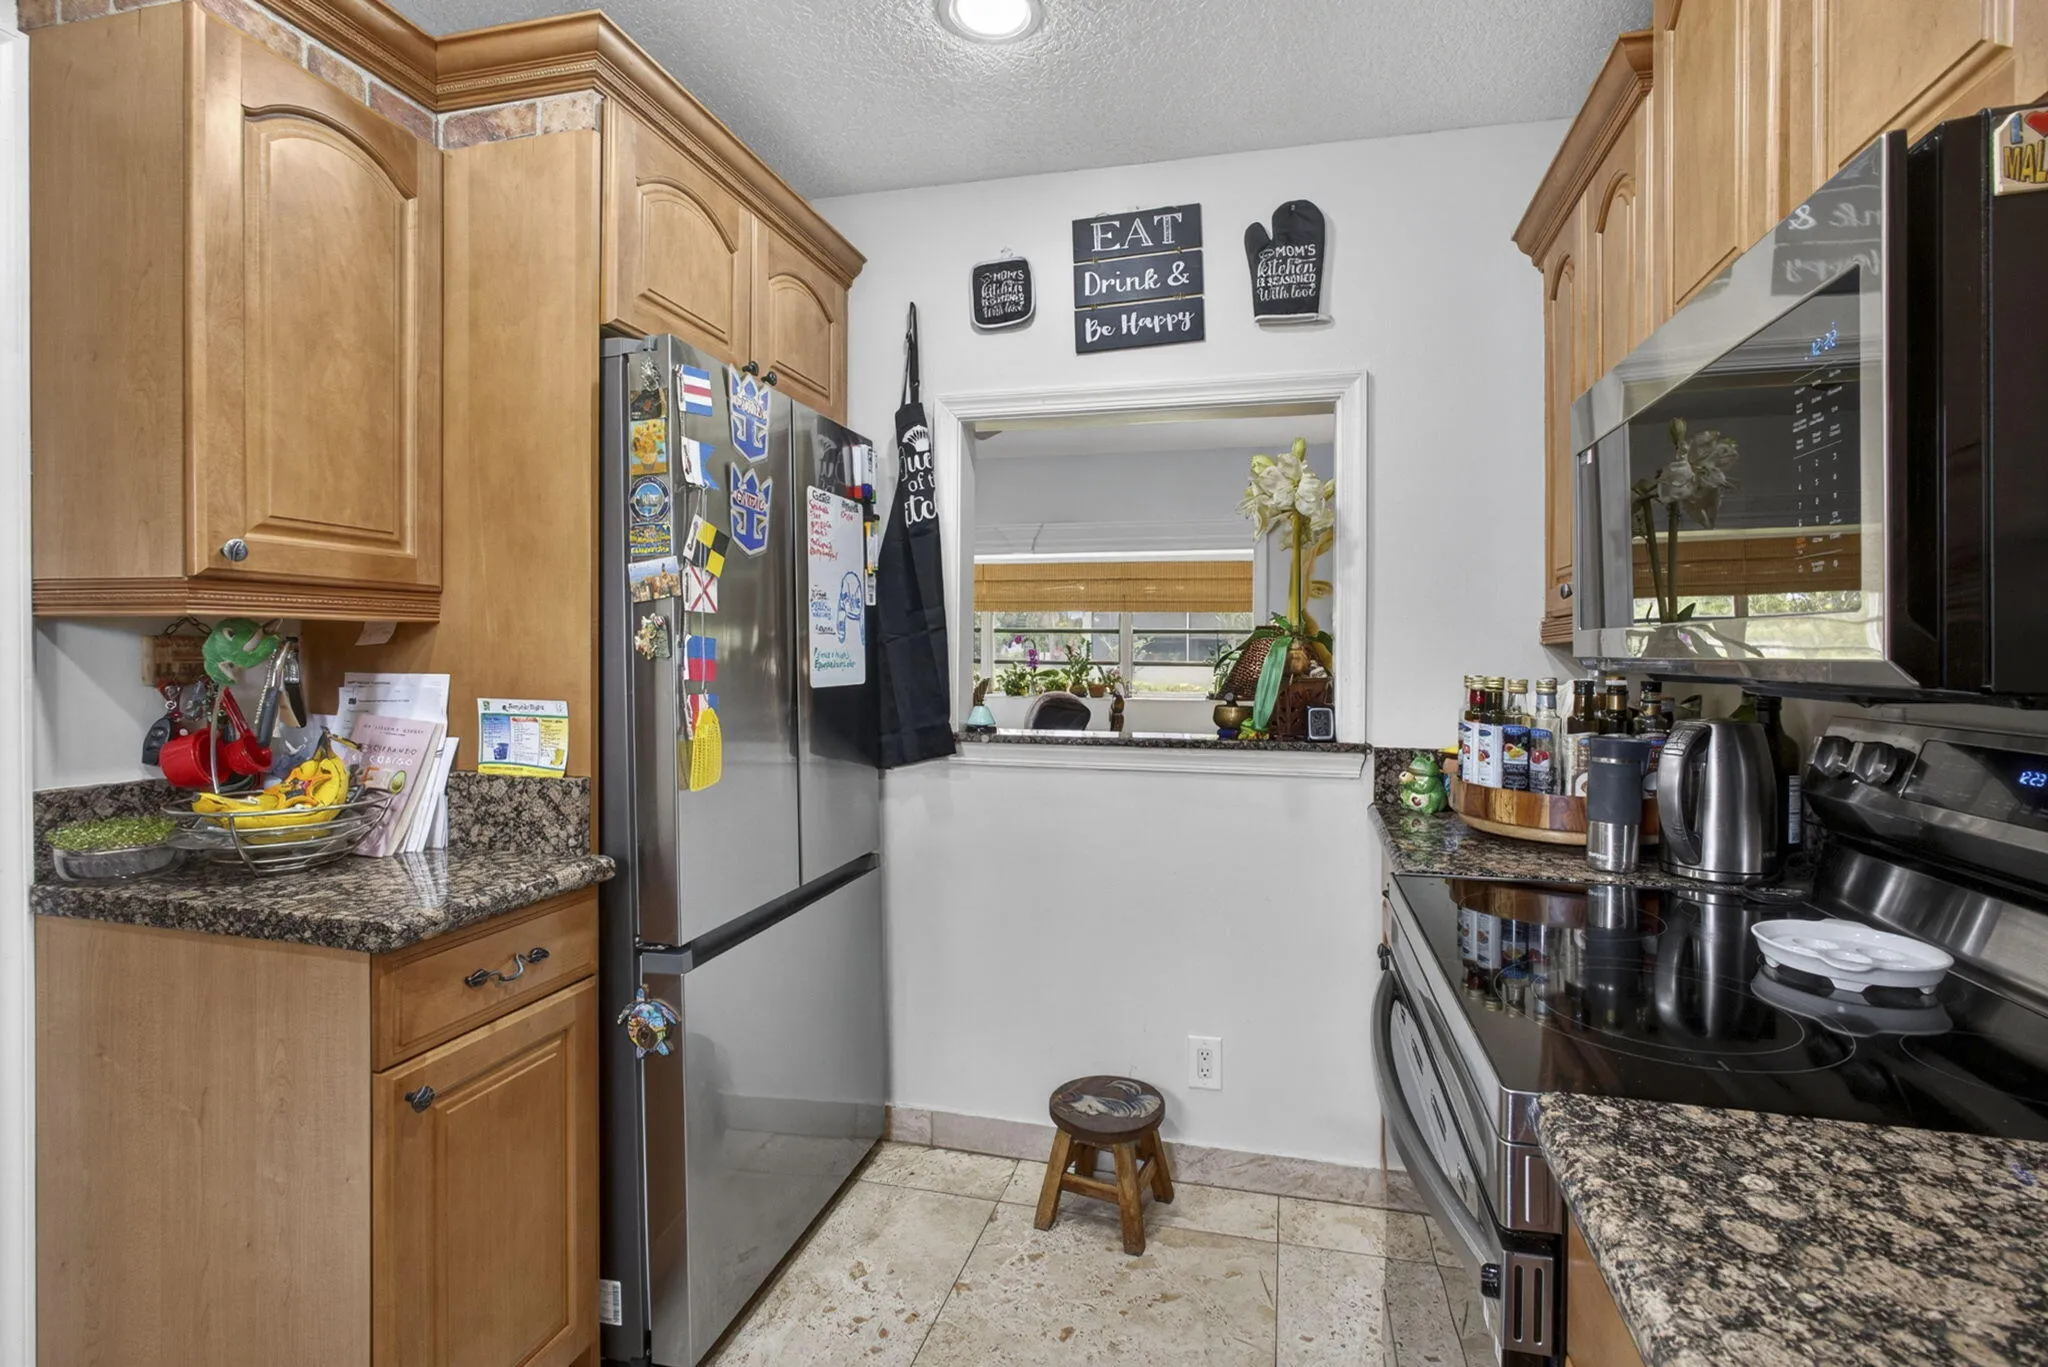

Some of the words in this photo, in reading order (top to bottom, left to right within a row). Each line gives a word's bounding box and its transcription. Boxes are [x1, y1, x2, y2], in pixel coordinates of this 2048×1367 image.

[2003, 139, 2048, 183] MAL
[1090, 212, 1182, 252] EAT
[1275, 243, 1317, 258] MOM'S
[1084, 267, 1161, 296] Drink
[1167, 260, 1190, 286] &
[1085, 318, 1115, 343] Be
[1121, 311, 1195, 335] Happy
[908, 472, 925, 492] of
